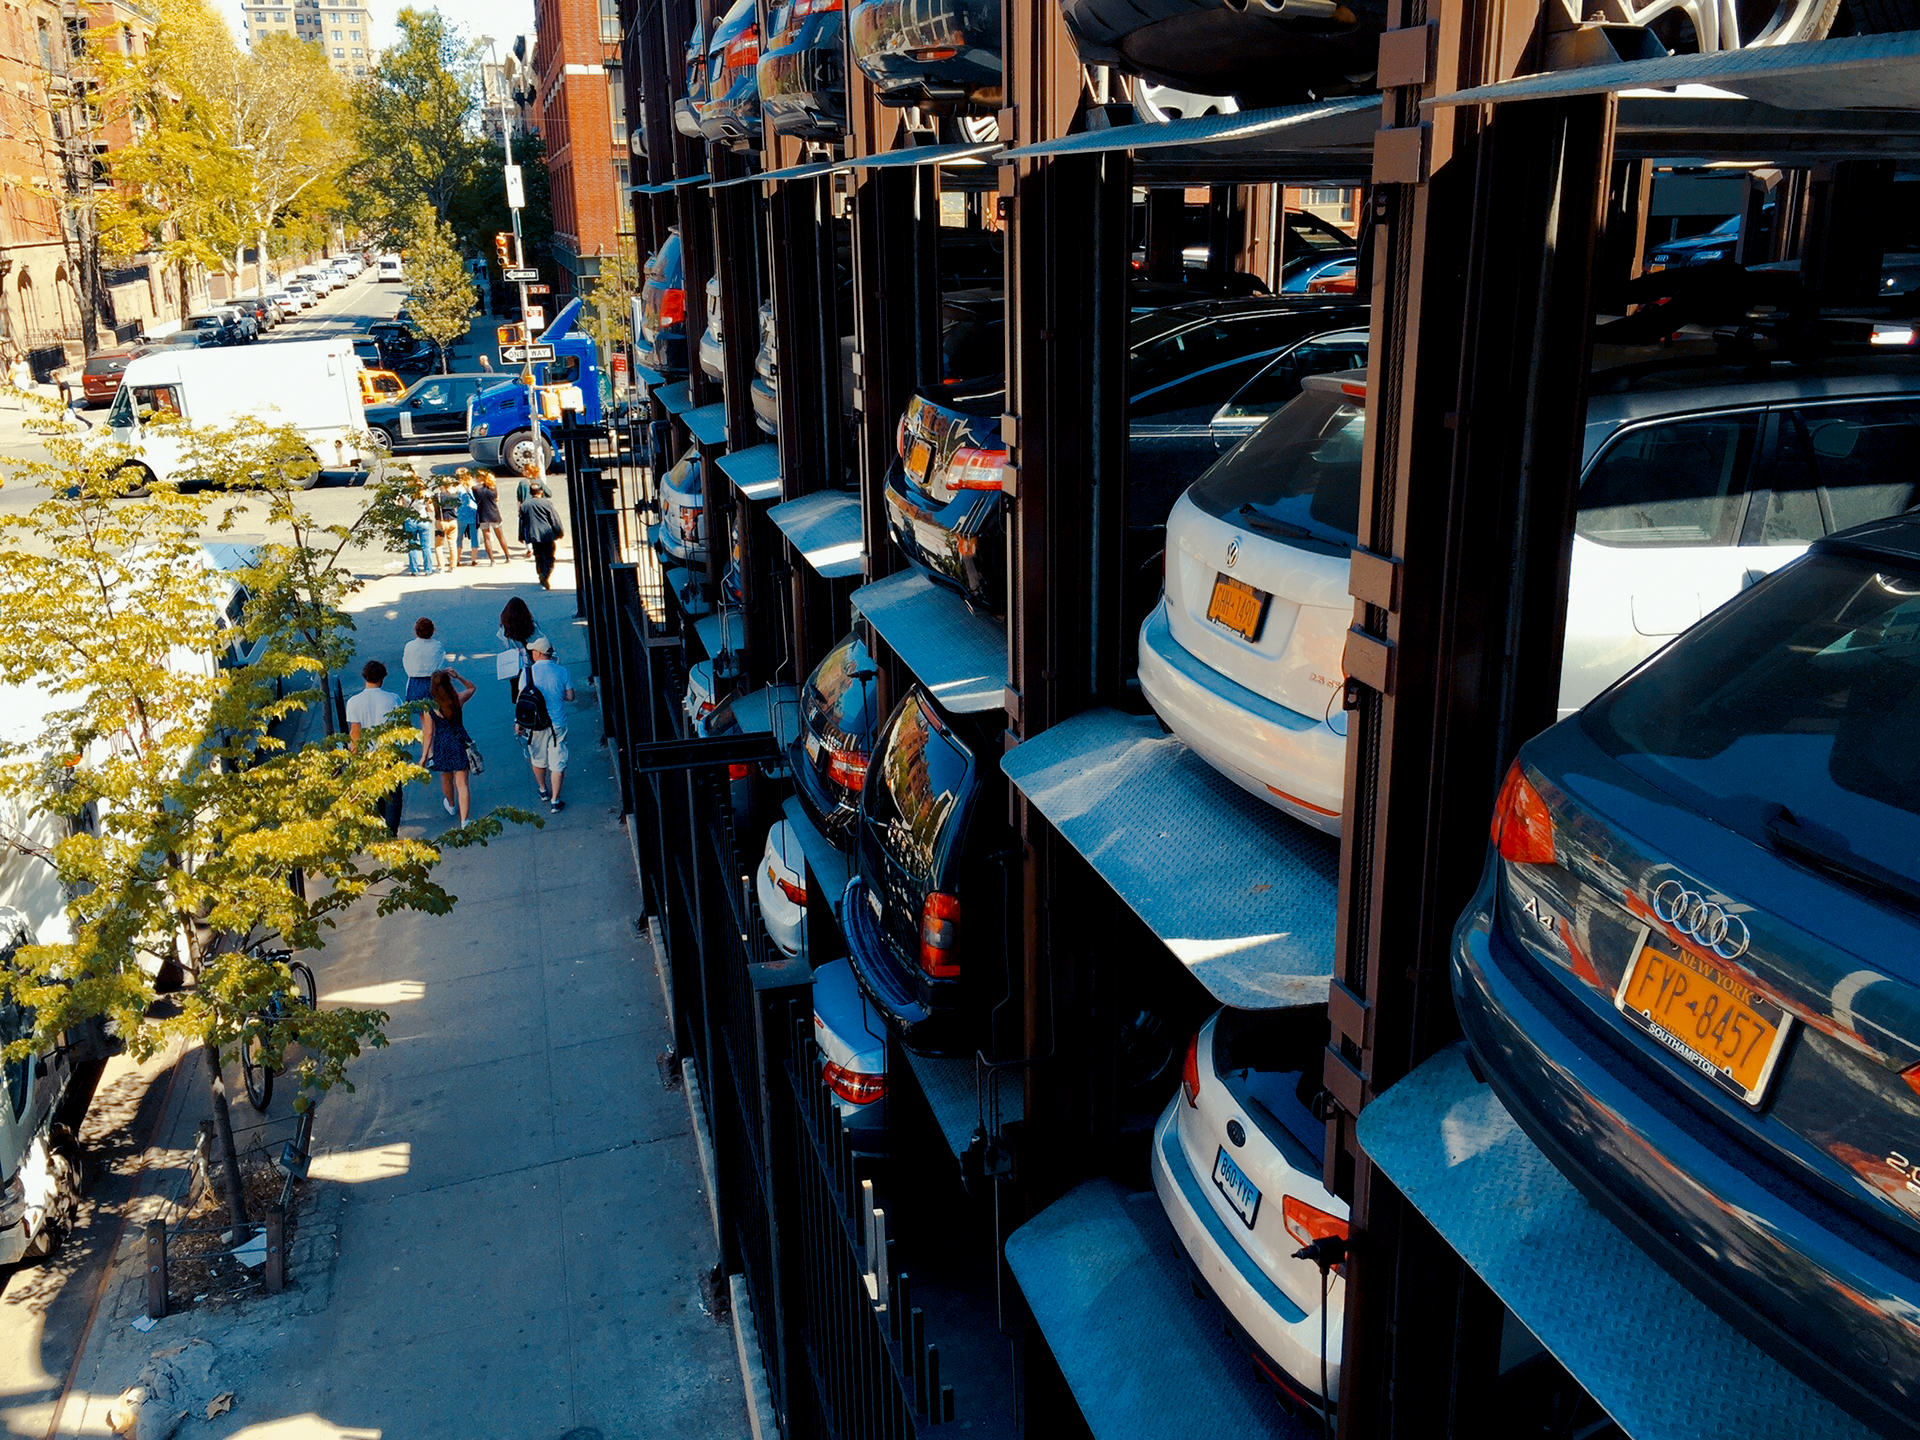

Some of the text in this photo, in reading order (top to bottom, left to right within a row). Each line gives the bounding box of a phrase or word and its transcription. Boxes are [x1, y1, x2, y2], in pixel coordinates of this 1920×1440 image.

[508, 349, 547, 358] ONE WAY
[1522, 896, 1553, 930] A4
[1678, 950, 1756, 1005] NEW YORK
[1648, 1022, 1718, 1078] SOUTHAMPTON
[1653, 1013, 1727, 1069] EMPIRE STATE
